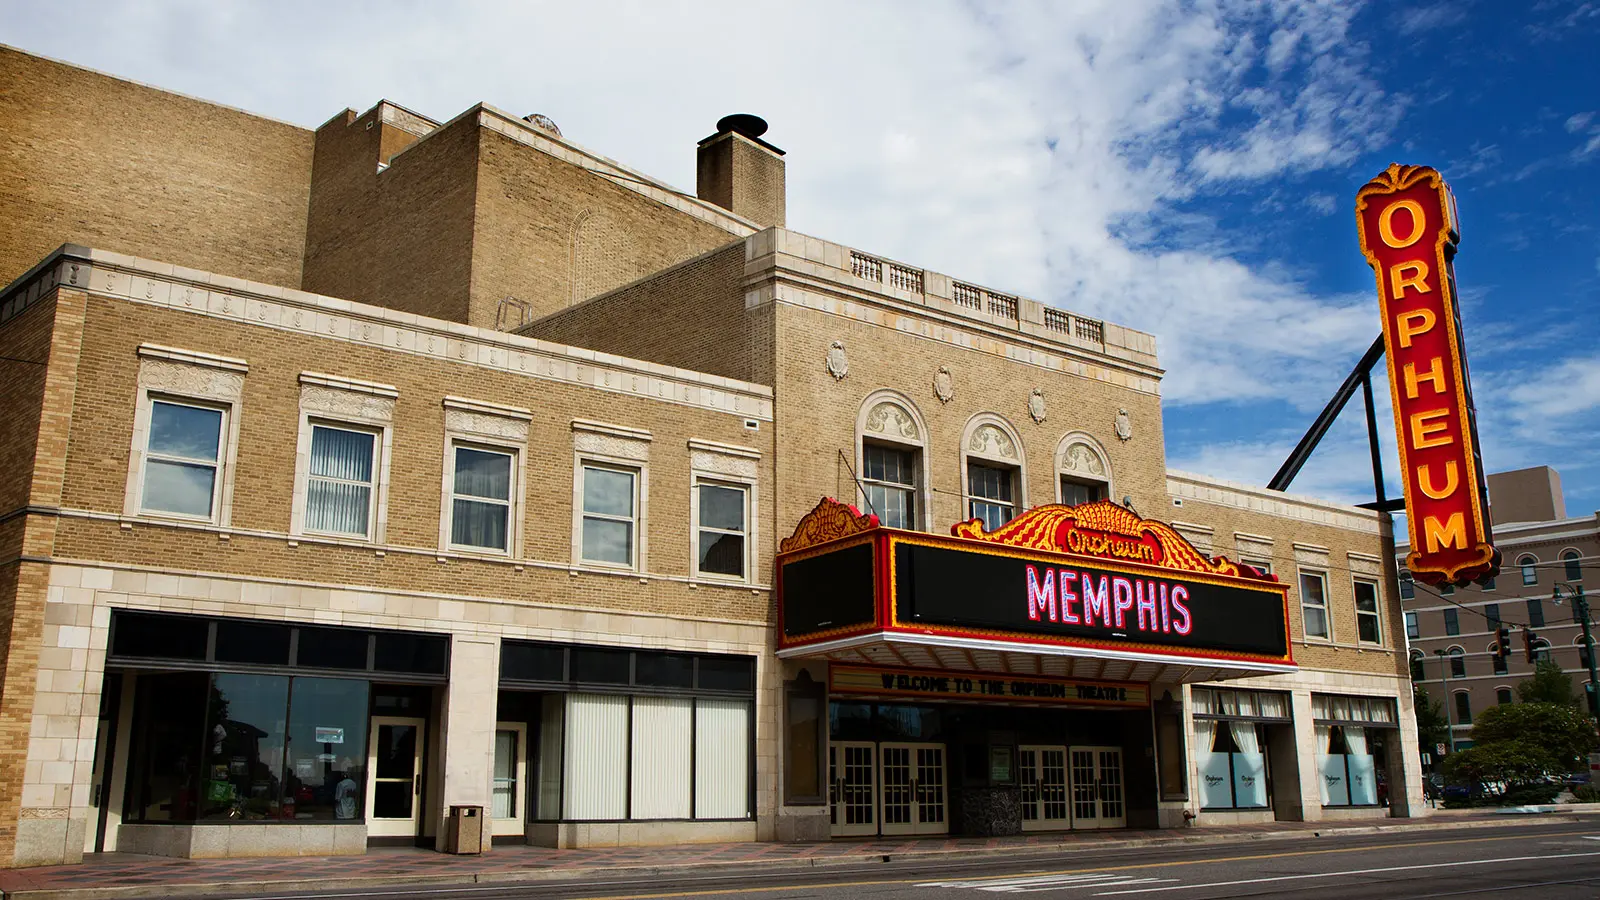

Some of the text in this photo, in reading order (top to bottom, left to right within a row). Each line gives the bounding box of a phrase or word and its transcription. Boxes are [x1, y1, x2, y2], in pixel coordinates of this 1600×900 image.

[1379, 199, 1467, 553] ORPHEUM
[1067, 527, 1155, 561] Orpheum
[1026, 564, 1192, 635] MEMPHIS
[881, 673, 1126, 701] WELCOME TO THE ORPHEUM THEATRE
